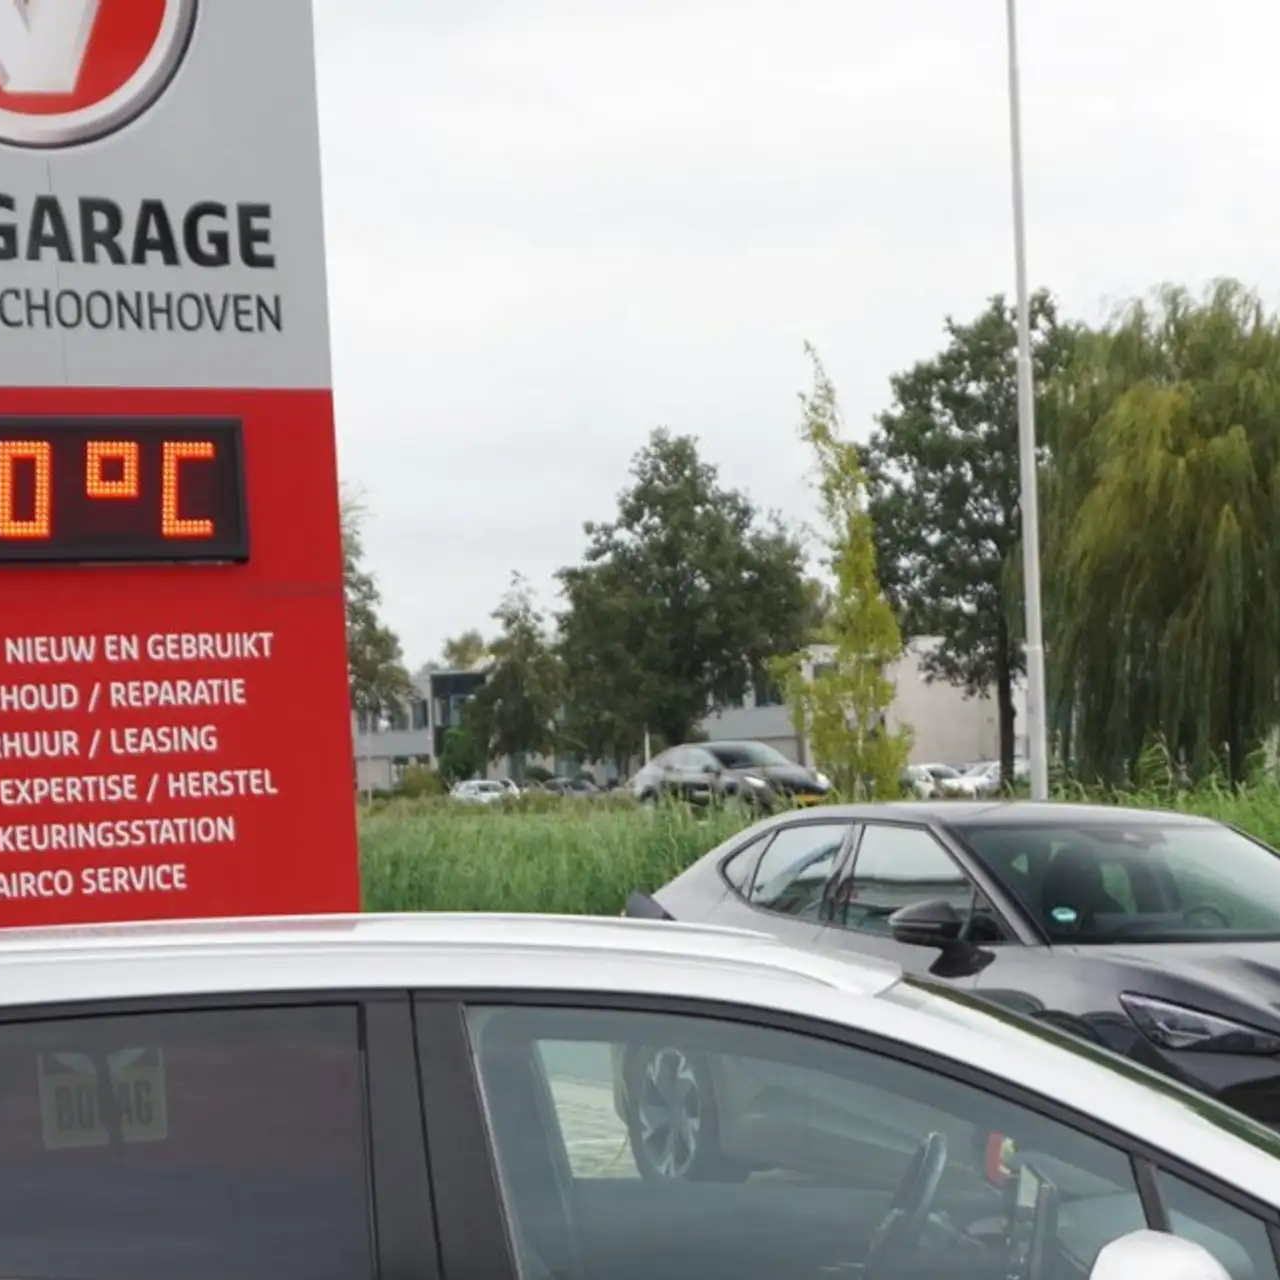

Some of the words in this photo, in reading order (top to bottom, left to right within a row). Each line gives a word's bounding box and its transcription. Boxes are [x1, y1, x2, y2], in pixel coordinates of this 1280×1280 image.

[5, 635, 96, 664] NIEUW
[104, 634, 140, 662] EN
[146, 632, 274, 662] GEBRUIKT
[109, 679, 246, 709] REPARATIE
[110, 725, 218, 755] LEASING
[0, 774, 137, 806] EXPERTISE
[168, 769, 278, 798] HERSTEL
[81, 864, 188, 895] SERVICE
